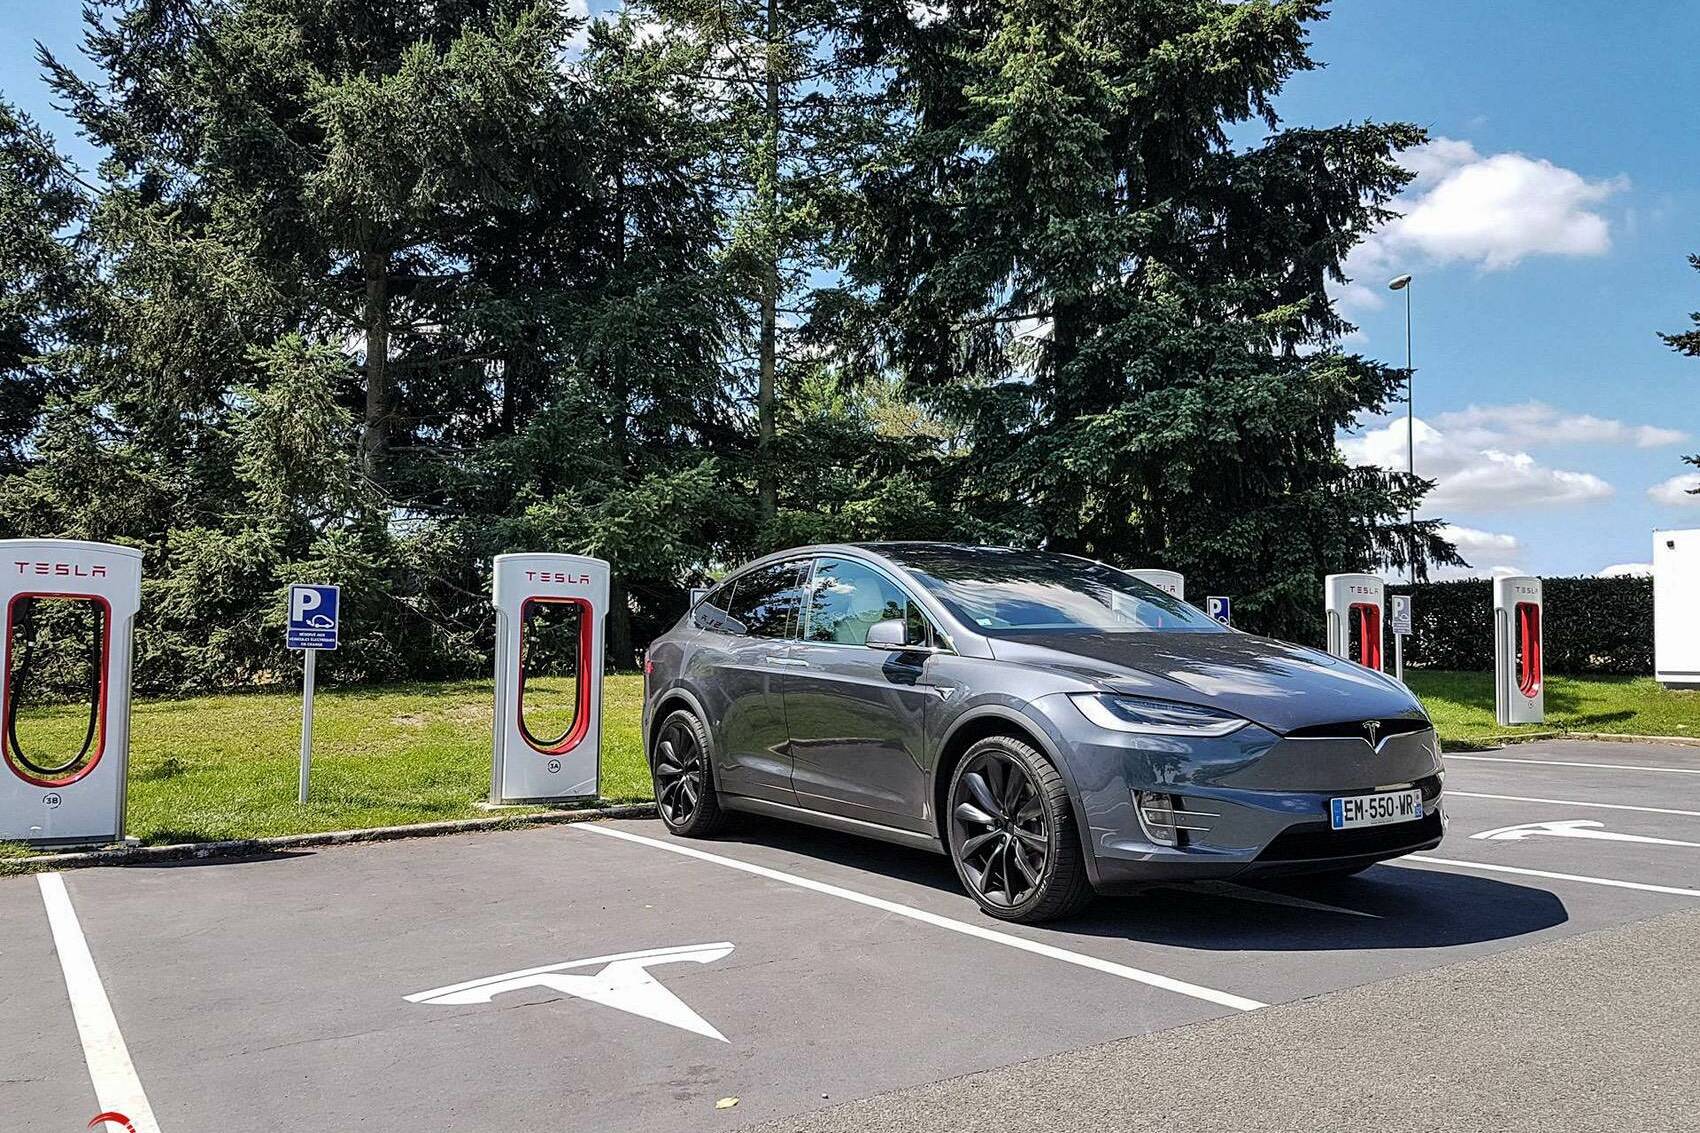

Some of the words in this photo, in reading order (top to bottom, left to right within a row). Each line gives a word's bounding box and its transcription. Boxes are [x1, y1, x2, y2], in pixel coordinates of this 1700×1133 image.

[14, 561, 106, 578] TESLA
[525, 571, 590, 585] TESLA
[1350, 585, 1379, 595] TESLA
[292, 587, 321, 621] P
[1209, 599, 1222, 619] P
[1394, 597, 1405, 619] P
